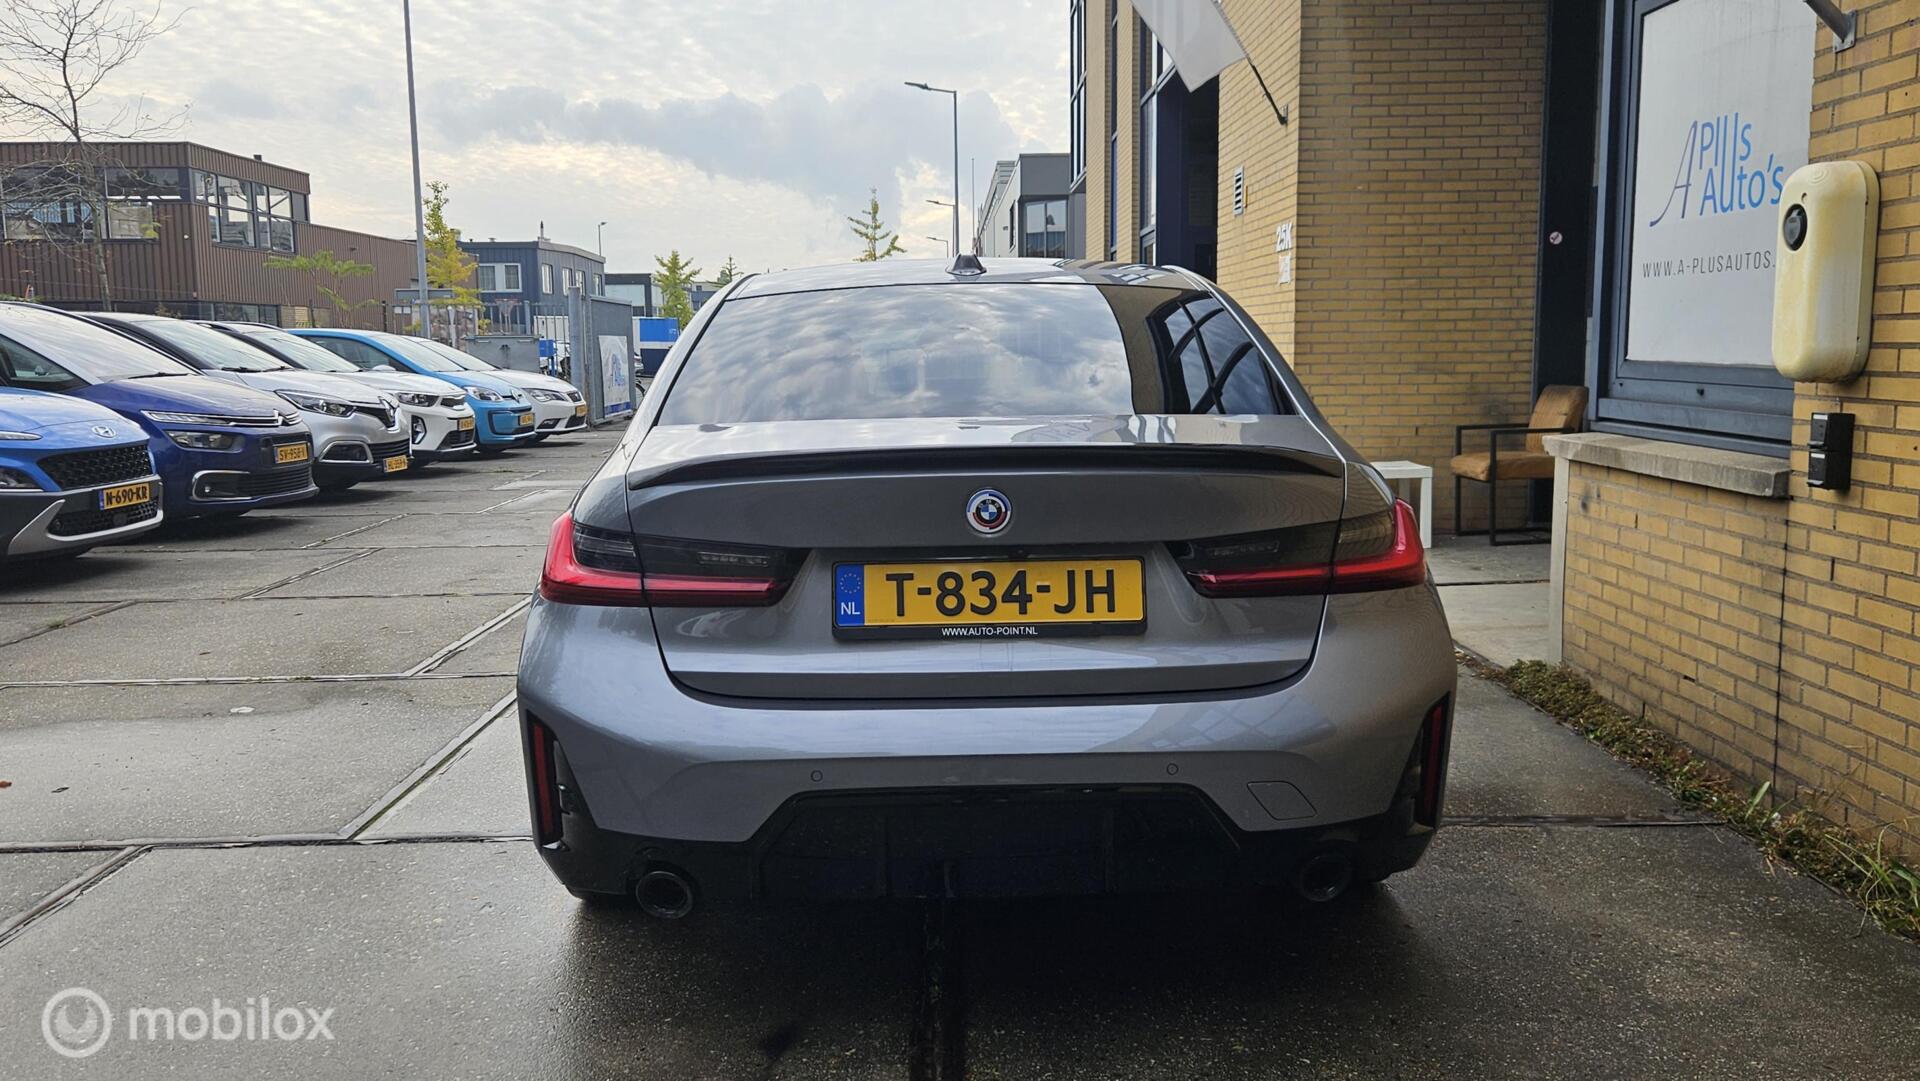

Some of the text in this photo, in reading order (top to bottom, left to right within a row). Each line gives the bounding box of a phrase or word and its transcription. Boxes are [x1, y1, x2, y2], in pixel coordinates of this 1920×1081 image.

[105, 485, 148, 506] N-690-KR
[885, 568, 1116, 618] T-834-JH
[840, 601, 861, 616] NL
[941, 625, 1039, 637] WWW.AUTO-POINT.NL
